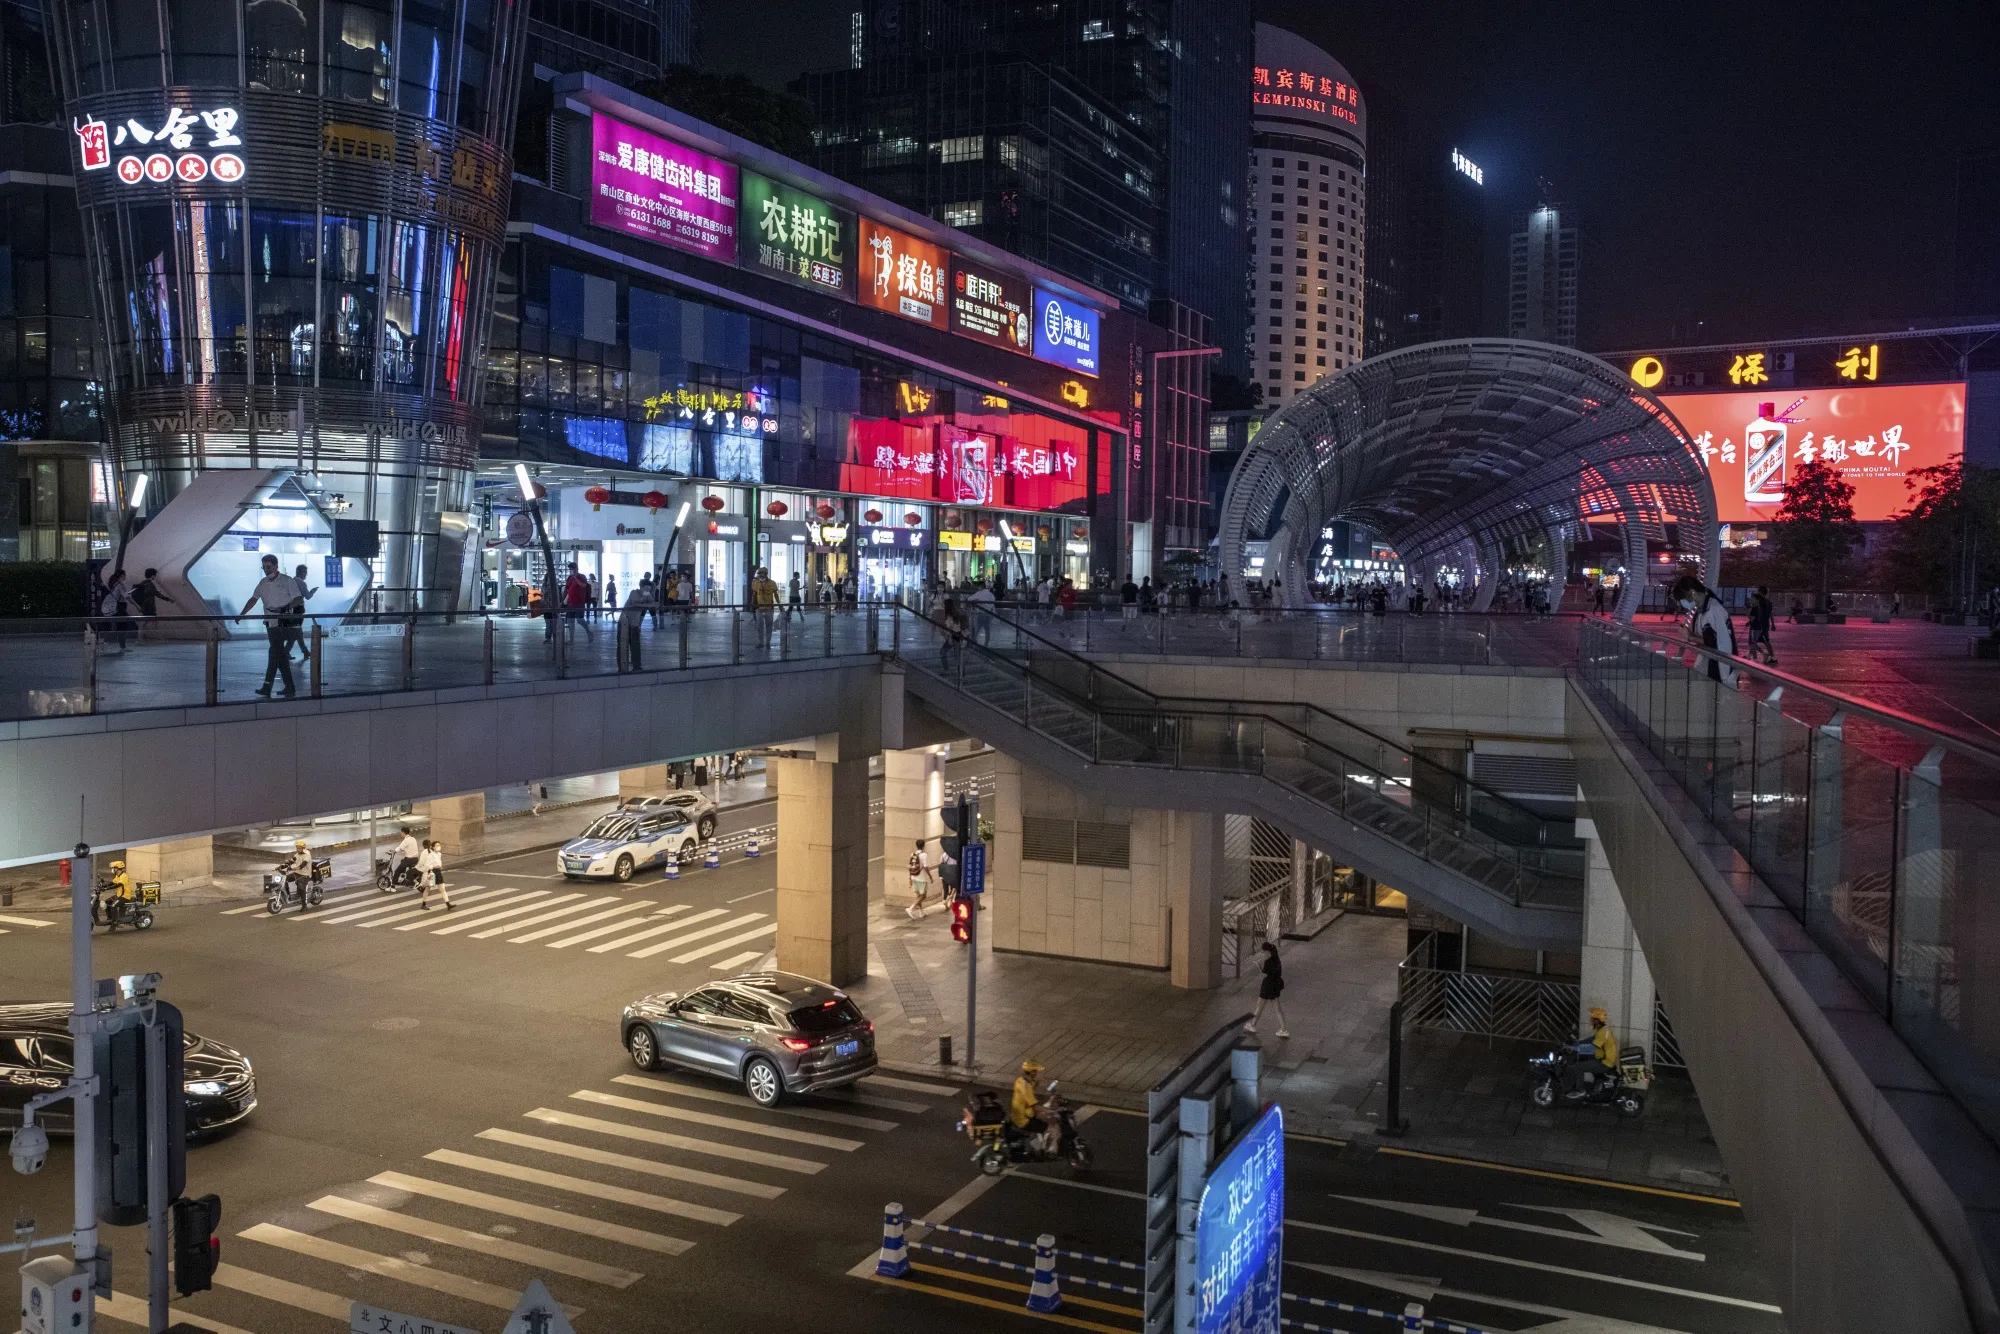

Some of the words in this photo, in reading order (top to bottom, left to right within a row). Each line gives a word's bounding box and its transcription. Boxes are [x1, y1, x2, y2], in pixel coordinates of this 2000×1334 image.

[1254, 66, 1358, 107] 凯宾斯基酒店
[1253, 92, 1326, 113] KEMPINSKI
[1332, 104, 1357, 125] HOTEL
[114, 107, 242, 149] 八合里
[120, 158, 243, 182] 牛肉火锅
[617, 141, 721, 203] 爱康健齿科集团
[631, 209, 650, 224] 6131
[652, 215, 672, 230] 1688
[681, 225, 700, 238] 6319
[701, 231, 719, 245] 8198
[760, 195, 843, 264] 农耕记
[759, 243, 810, 279] 湖南土菜
[812, 263, 843, 287] 本座3F
[1063, 315, 1090, 342] 奈瑞儿
[1728, 344, 1878, 385] 保利
[625, 527, 646, 535] HUAWEI
[360, 1309, 371, 1323] 北
